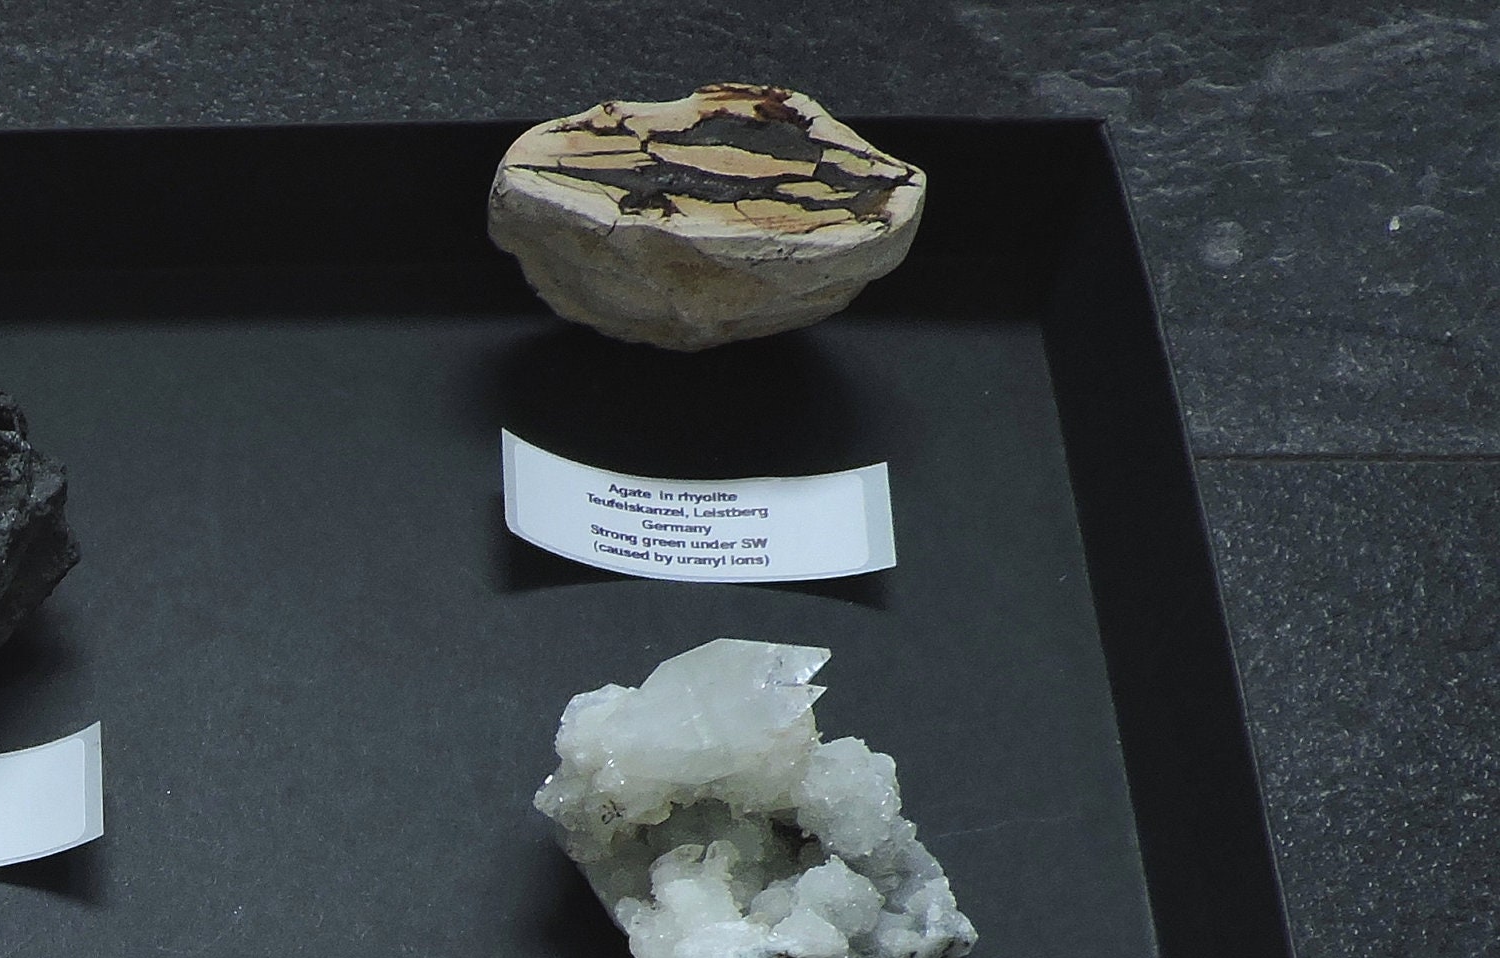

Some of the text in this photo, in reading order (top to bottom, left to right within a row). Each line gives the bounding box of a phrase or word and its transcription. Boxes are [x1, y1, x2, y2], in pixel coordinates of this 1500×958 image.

[608, 483, 738, 505] Agate in rhyolite
[590, 524, 768, 549] Strong green under SW
[642, 520, 712, 535] Germany
[593, 540, 770, 568] (caused by uranyl ions)
